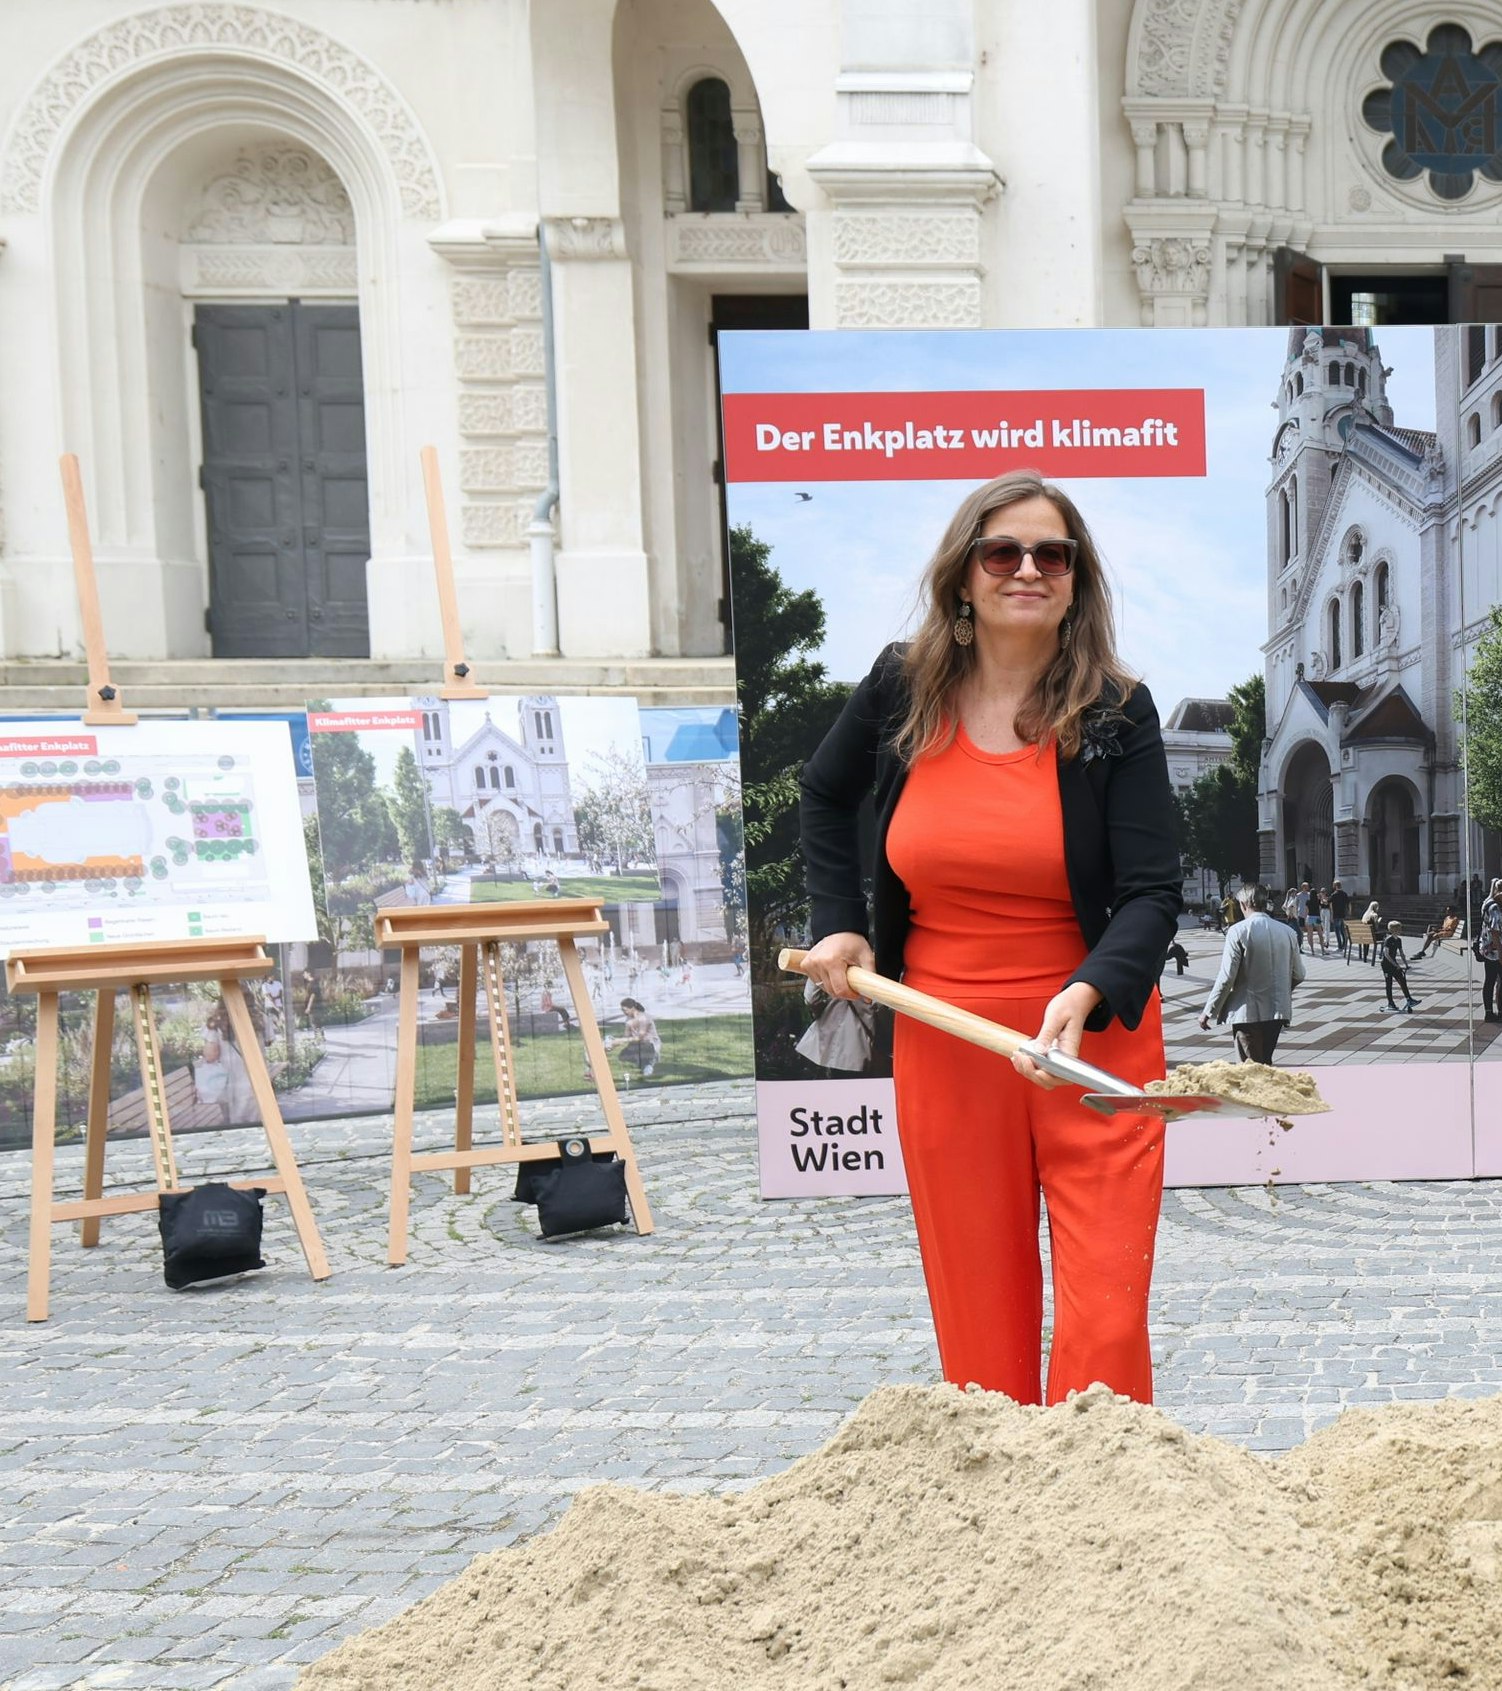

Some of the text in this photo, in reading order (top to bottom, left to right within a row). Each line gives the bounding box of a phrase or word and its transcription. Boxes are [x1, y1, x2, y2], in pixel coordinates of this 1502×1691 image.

[755, 418, 1179, 458] Der Enkplatz wird klimafit
[315, 714, 416, 727] Klimafitter Enkplatz
[41, 741, 90, 752] Enkplatz
[789, 1105, 883, 1137] Stadt
[790, 1142, 885, 1172] Wien
